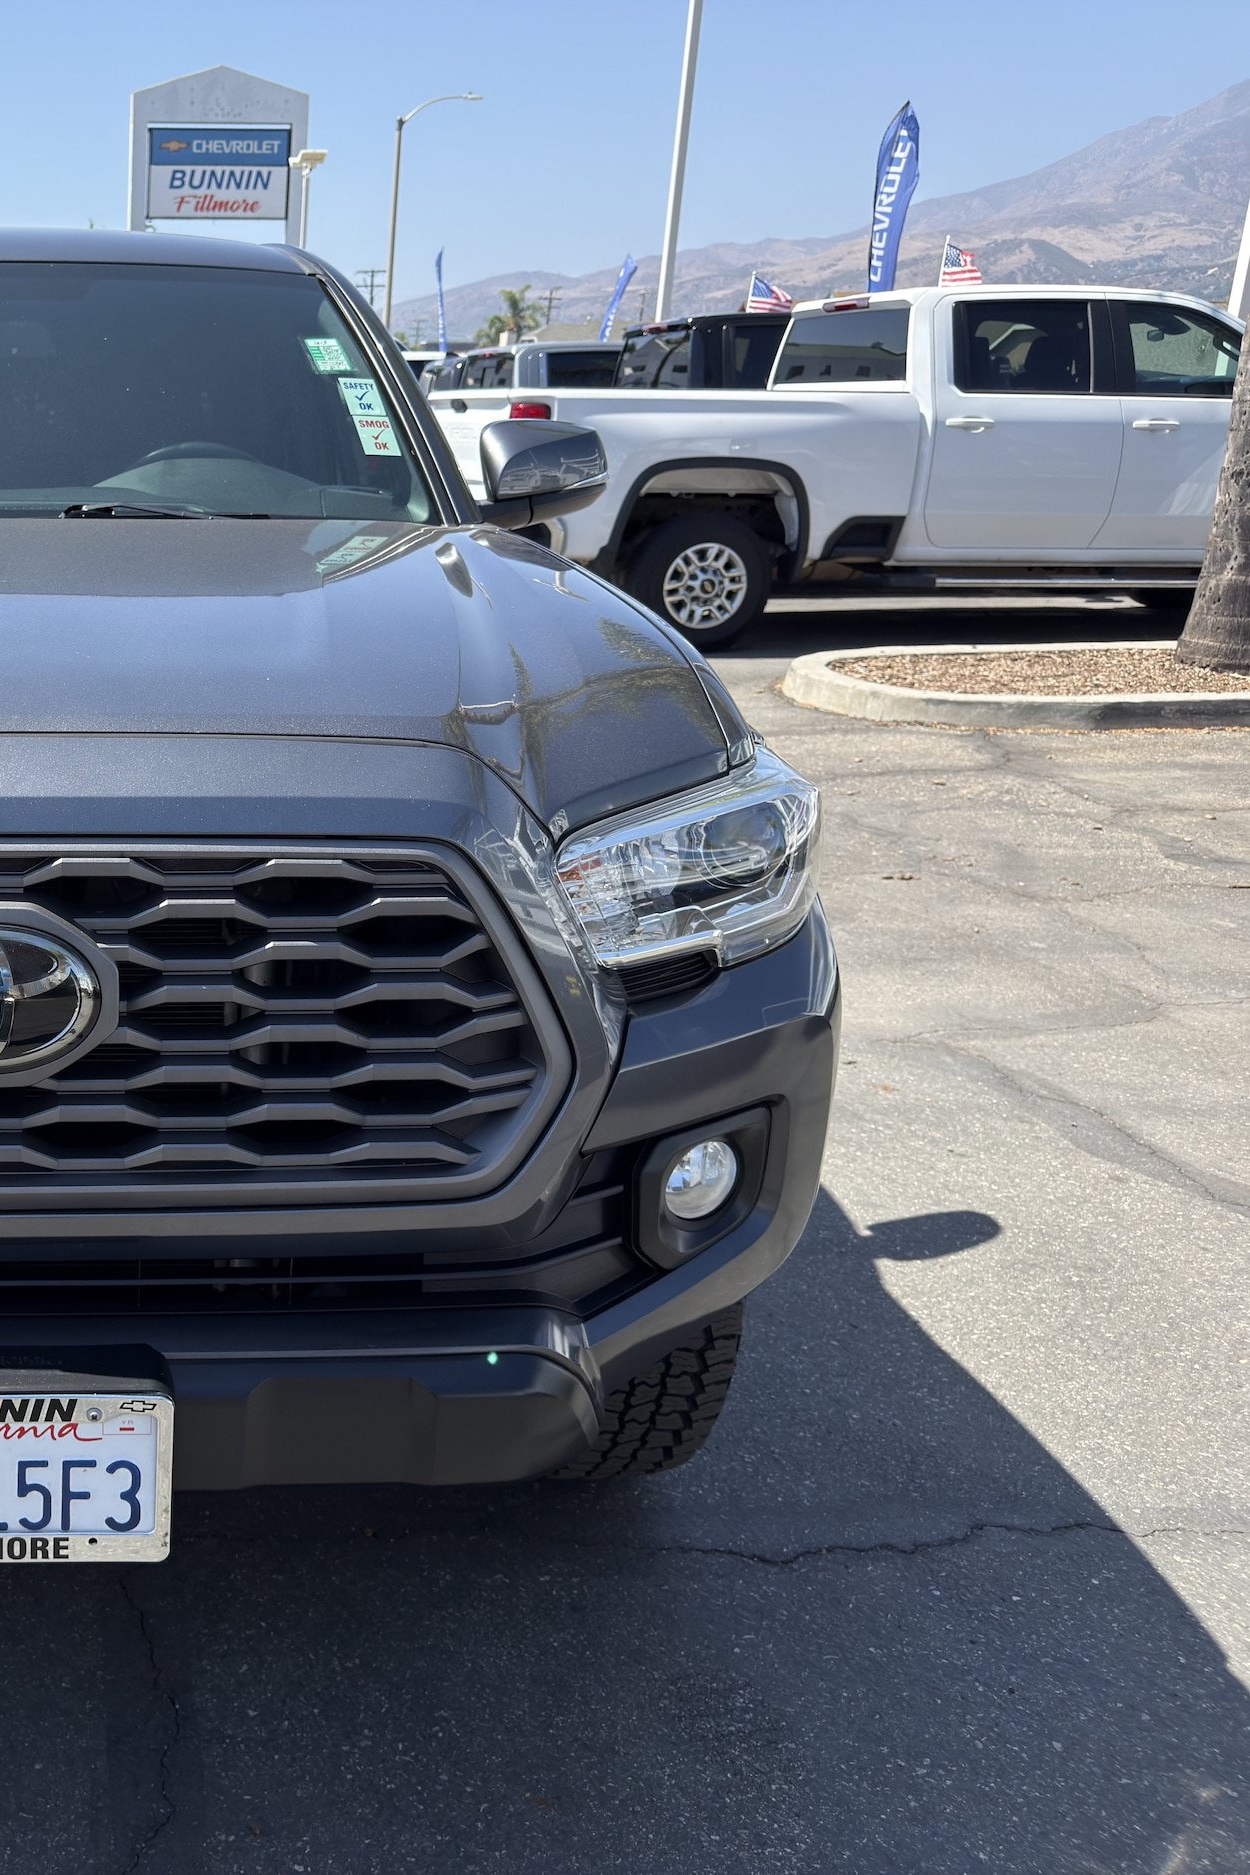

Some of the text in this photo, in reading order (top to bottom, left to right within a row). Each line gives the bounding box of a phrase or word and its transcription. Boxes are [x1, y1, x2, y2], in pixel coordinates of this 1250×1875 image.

[192, 140, 281, 154] CHEVROLET
[168, 169, 272, 190] BUNNIN
[173, 194, 261, 213] Fillmore
[343, 382, 374, 391] SAFETY
[359, 402, 374, 411] OK
[358, 419, 389, 429] SMOG
[374, 441, 389, 451] OK
